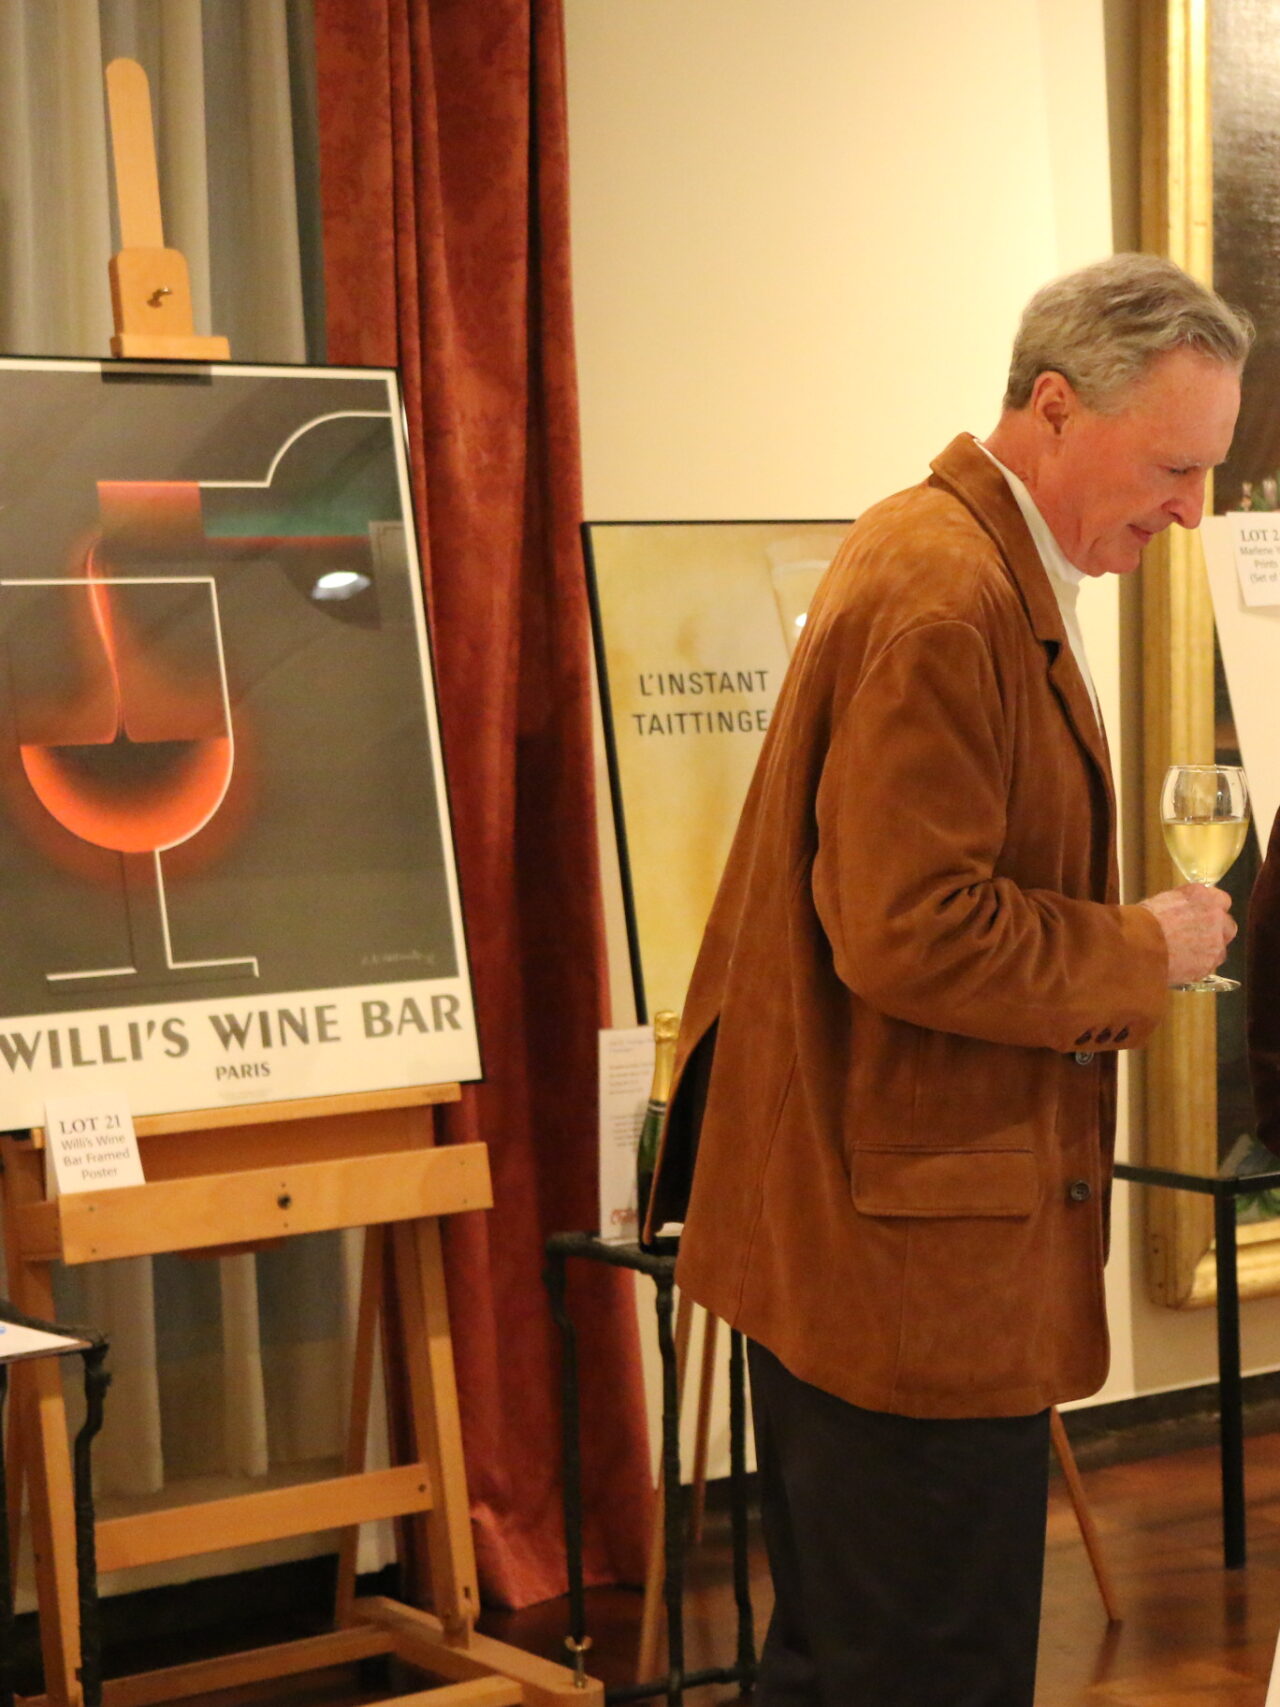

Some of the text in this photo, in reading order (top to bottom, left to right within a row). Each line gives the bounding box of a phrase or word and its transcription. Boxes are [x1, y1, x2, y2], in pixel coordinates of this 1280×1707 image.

[1240, 529, 1268, 542] LOT
[640, 671, 768, 696] L'INSTANT
[632, 710, 767, 735] TAITTINGE
[0, 994, 463, 1074] WILLI'S WINE BAR
[215, 1062, 272, 1082] PARIS
[59, 1114, 121, 1135] LOT 21
[61, 1134, 126, 1151] Willi's Wine
[63, 1147, 130, 1167] Bar Framed
[81, 1167, 118, 1180] Poster
